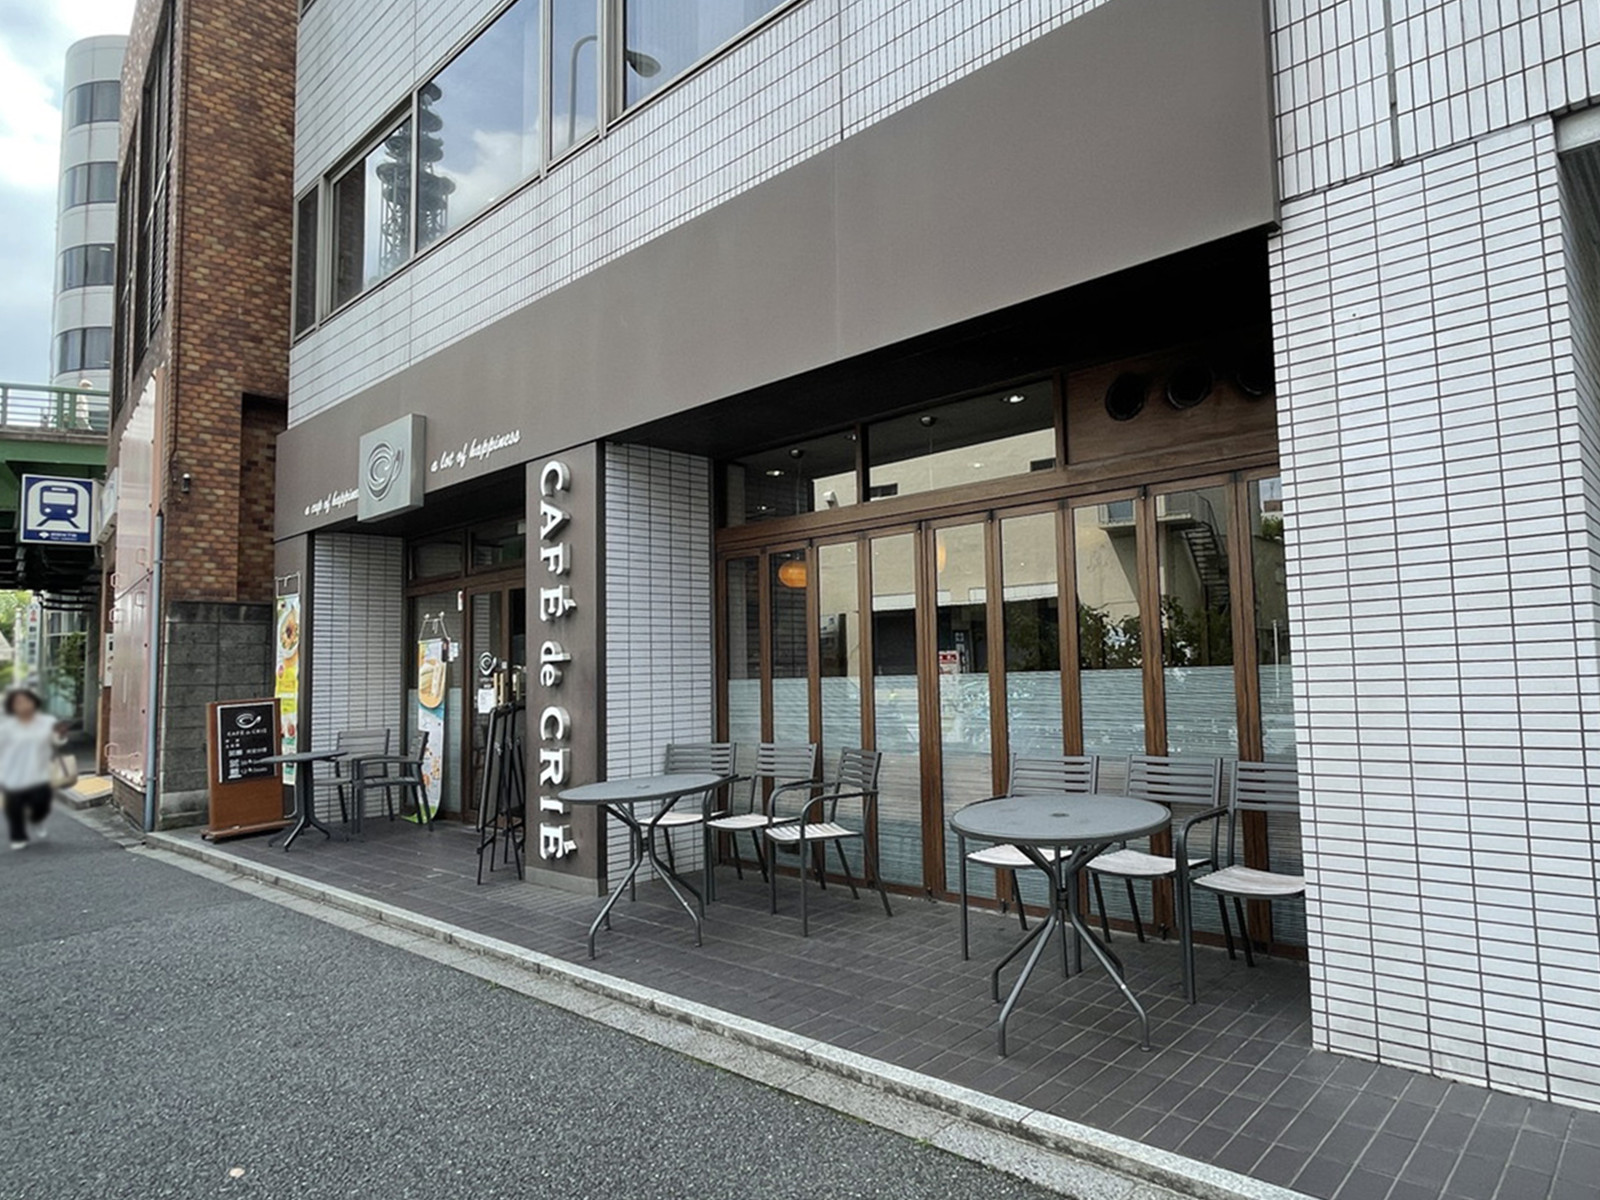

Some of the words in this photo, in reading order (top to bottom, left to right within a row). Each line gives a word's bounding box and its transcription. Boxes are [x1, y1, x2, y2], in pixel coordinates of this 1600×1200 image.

[430, 460, 439, 473] a
[440, 451, 455, 470] lot
[456, 442, 468, 469] of
[469, 430, 520, 461] happiness
[540, 460, 578, 622] CAFÉ
[540, 640, 572, 687] de
[540, 706, 578, 860] CRIÉ
